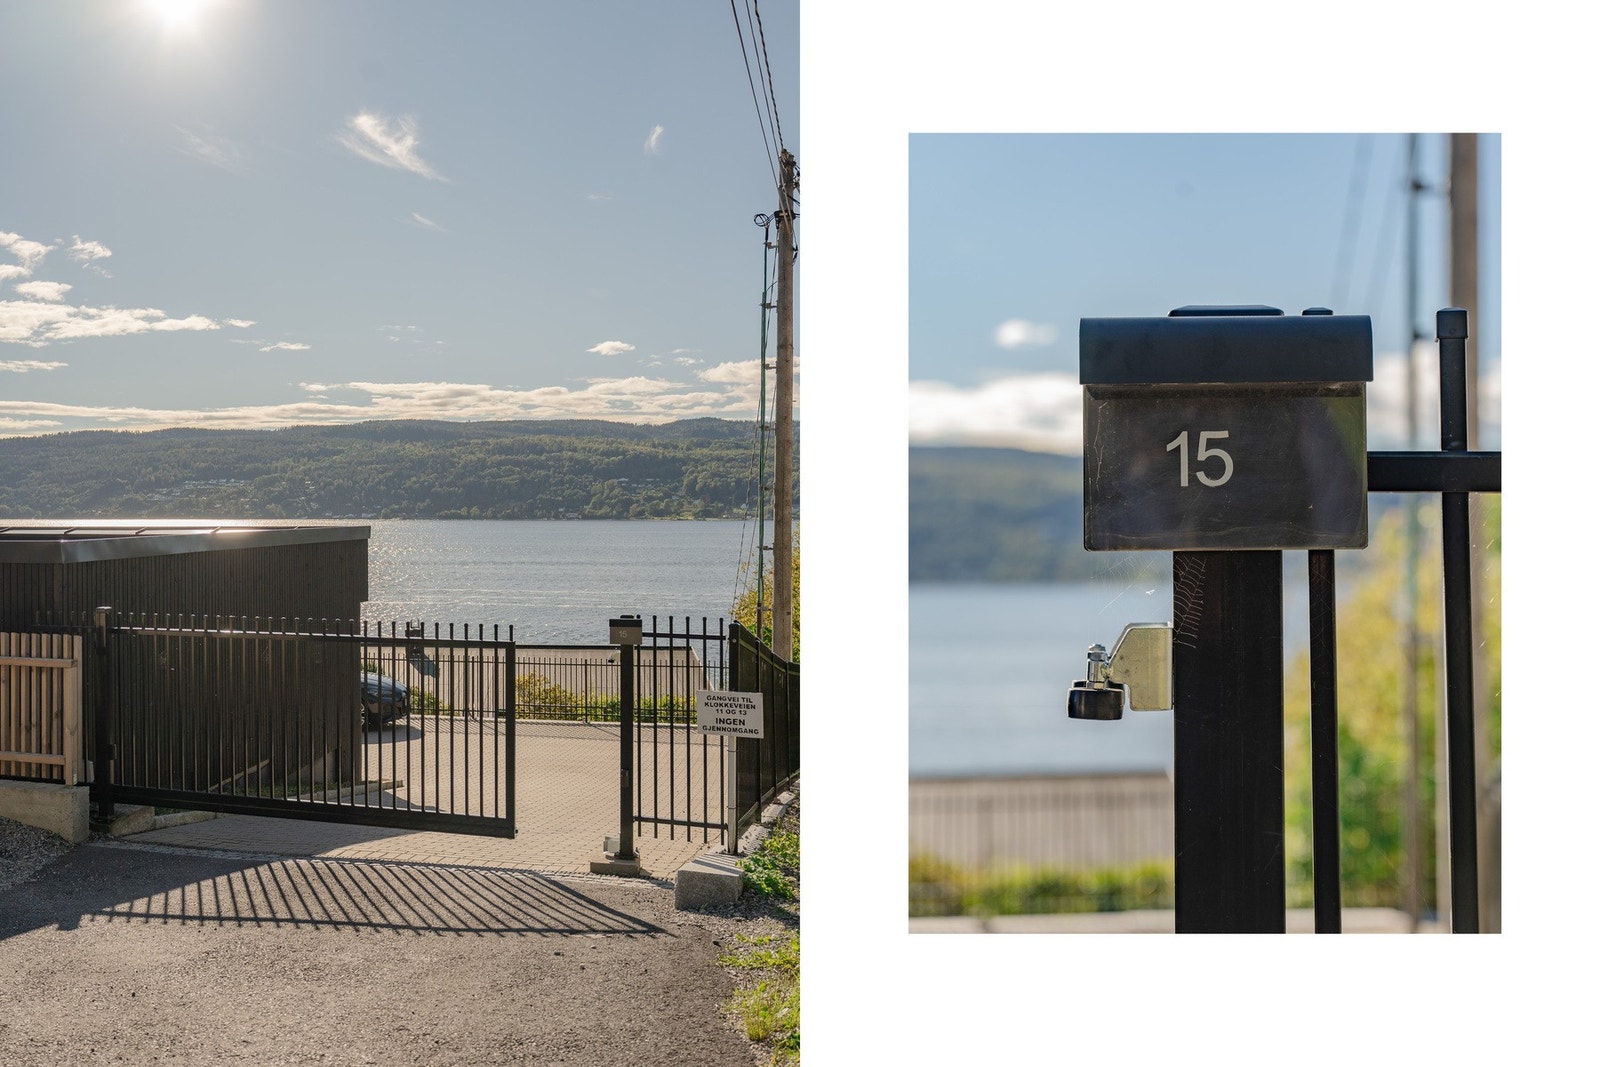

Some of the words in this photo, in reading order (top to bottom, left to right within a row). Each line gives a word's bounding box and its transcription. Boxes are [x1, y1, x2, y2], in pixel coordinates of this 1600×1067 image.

[1166, 430, 1234, 487] 15
[618, 630, 628, 638] 15
[715, 718, 745, 726] INGEN
[702, 725, 759, 734] GJENNOMGANG
